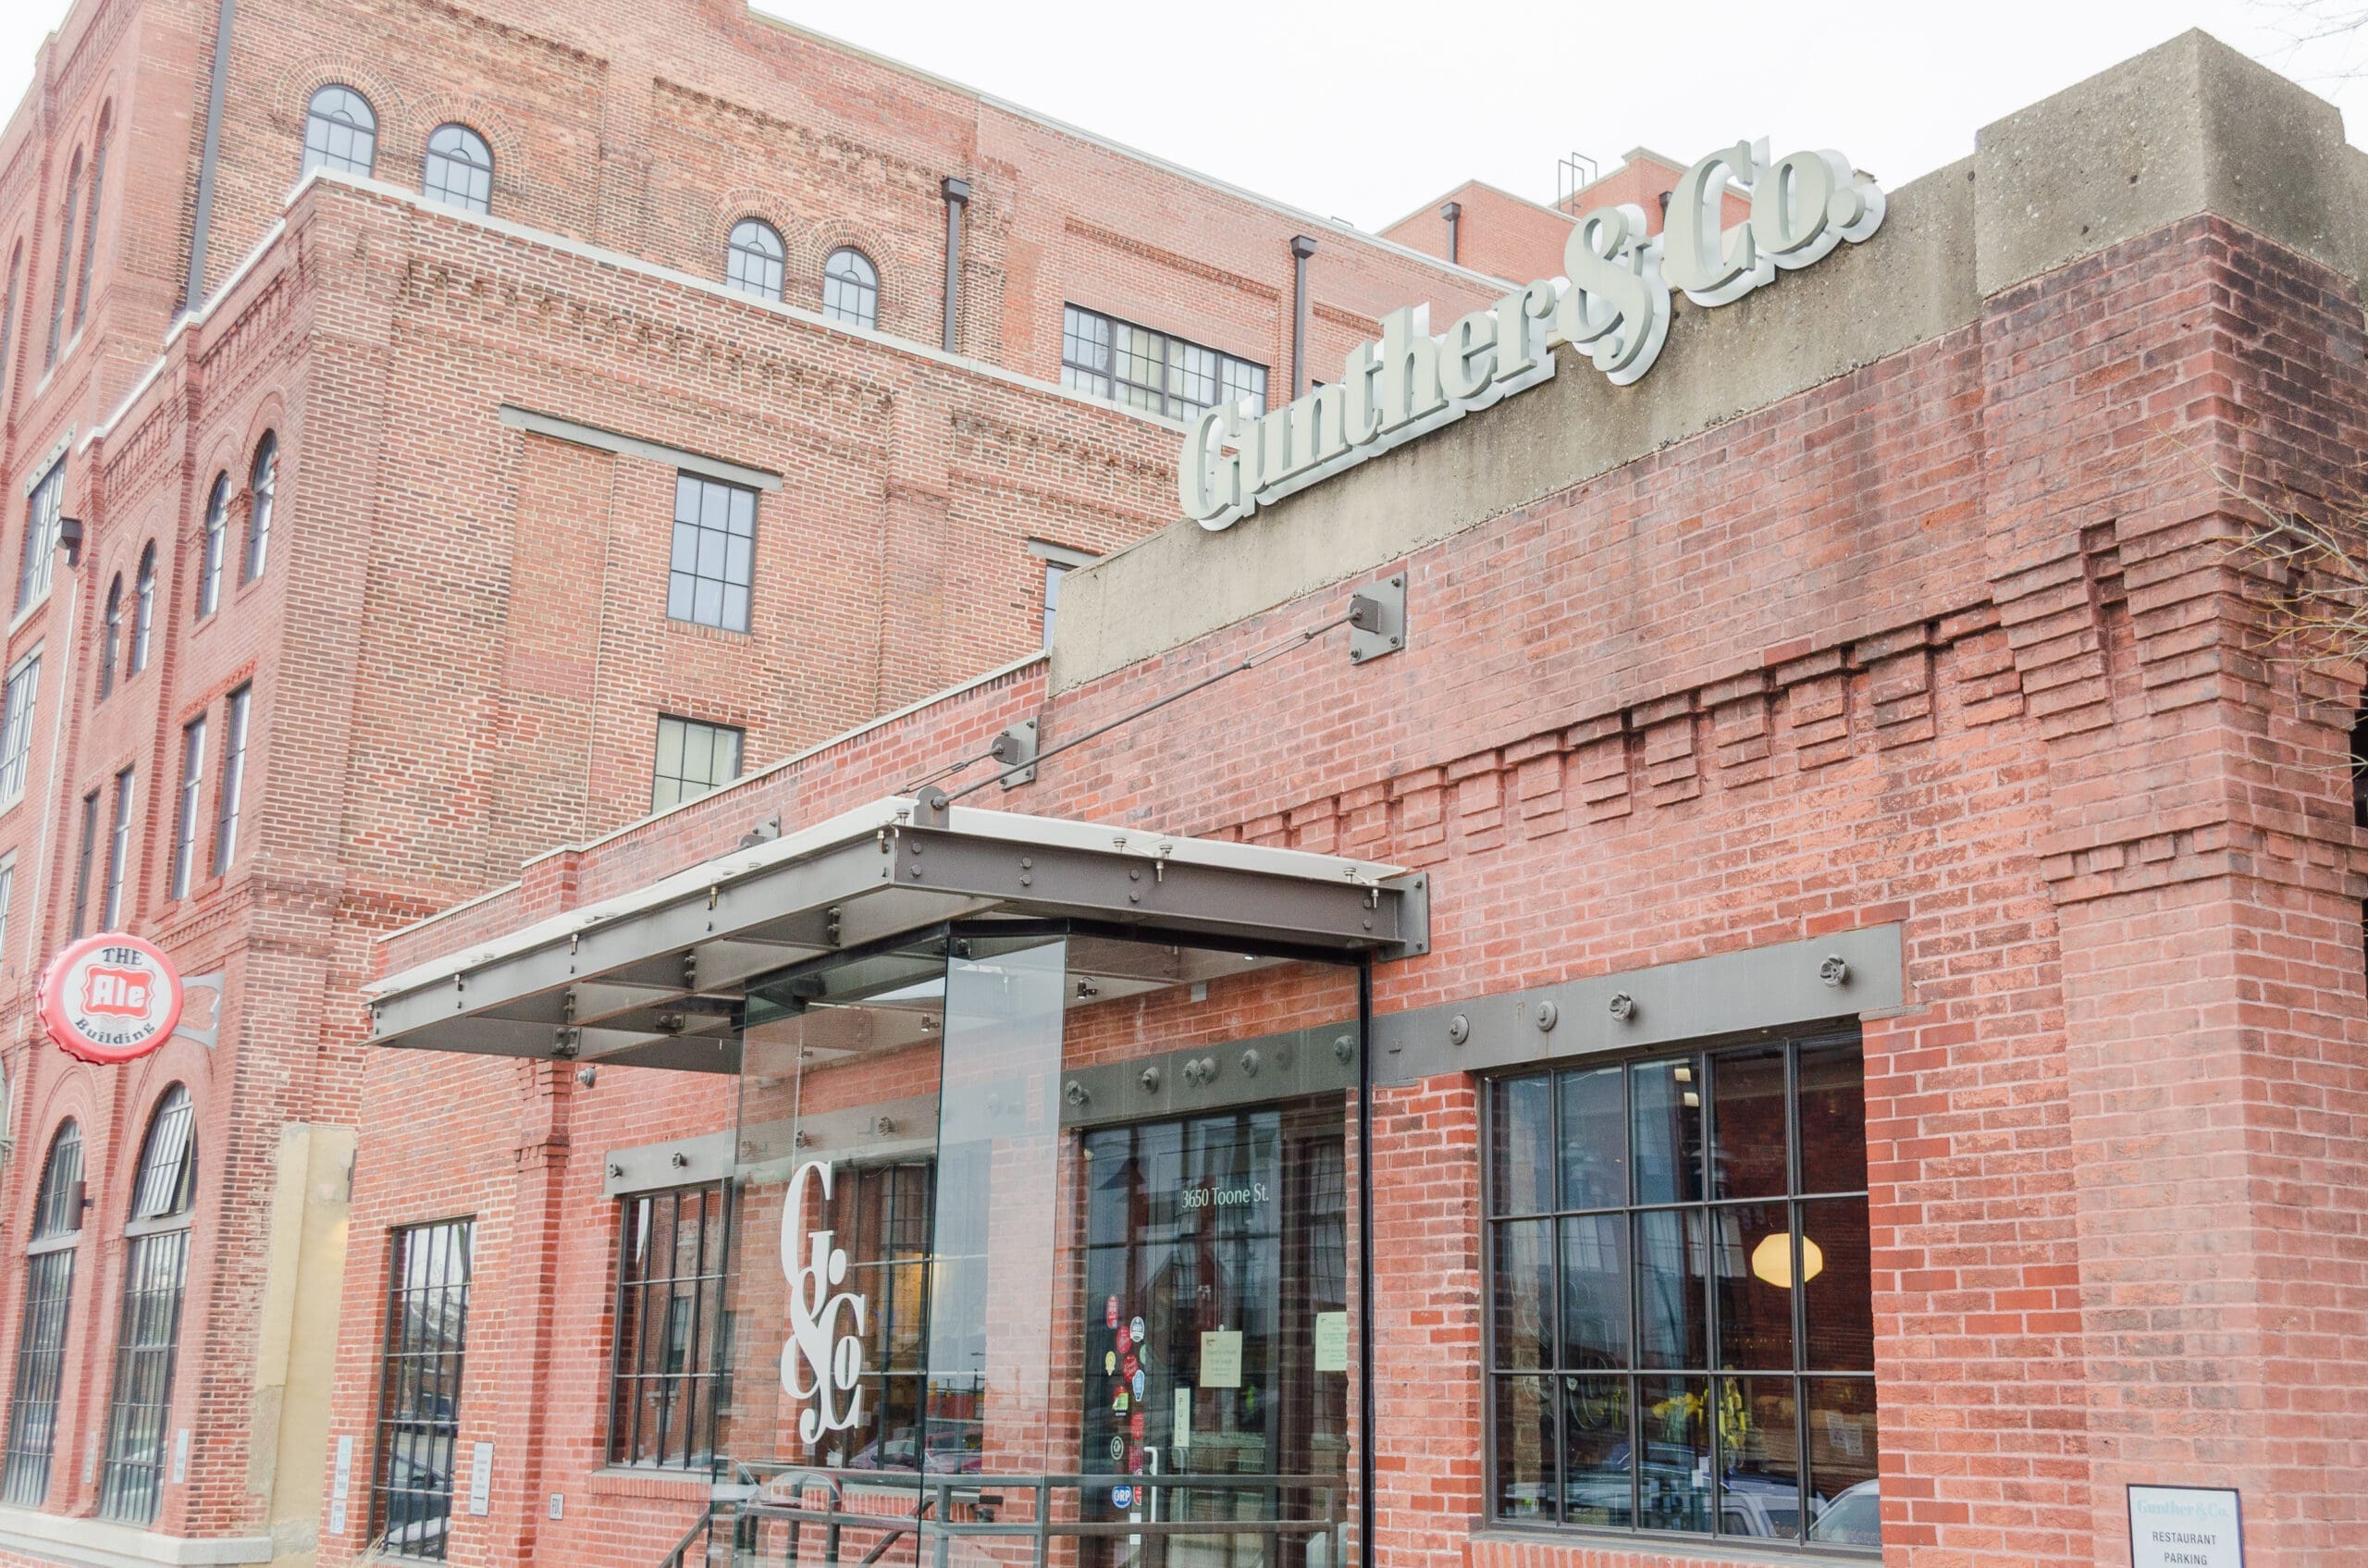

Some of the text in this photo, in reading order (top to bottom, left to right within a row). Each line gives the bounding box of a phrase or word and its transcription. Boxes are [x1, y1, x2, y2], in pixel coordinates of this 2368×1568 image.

[1178, 138, 1881, 525] Gunther & Co.
[102, 947, 142, 966] THE
[91, 974, 146, 1007] Ale
[75, 1017, 155, 1044] Building
[1181, 1181, 1270, 1209] 3650 Toone St.
[1177, 1396, 1185, 1443] PULL
[2137, 1499, 2195, 1516] Gunther
[2195, 1502, 2208, 1520] &
[2152, 1531, 2217, 1545] RESTAURANT
[2164, 1551, 2208, 1565] PARKING
